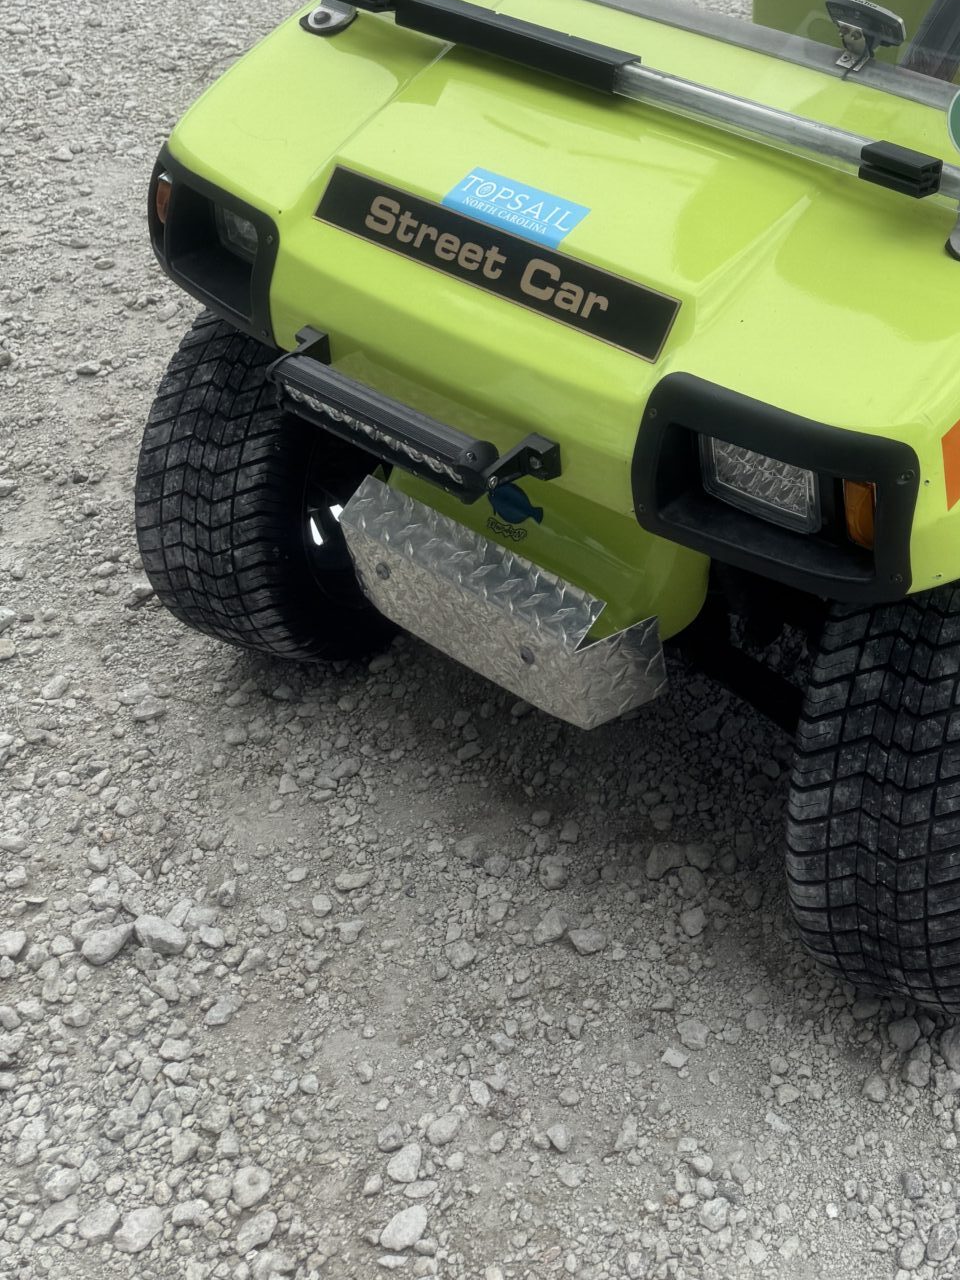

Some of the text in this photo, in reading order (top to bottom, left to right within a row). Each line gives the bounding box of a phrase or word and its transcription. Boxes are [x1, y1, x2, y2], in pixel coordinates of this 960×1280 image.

[461, 175, 572, 232] TOPSAIL
[462, 196, 548, 234] NORTH CAROLINA
[364, 195, 609, 320] Street Car
